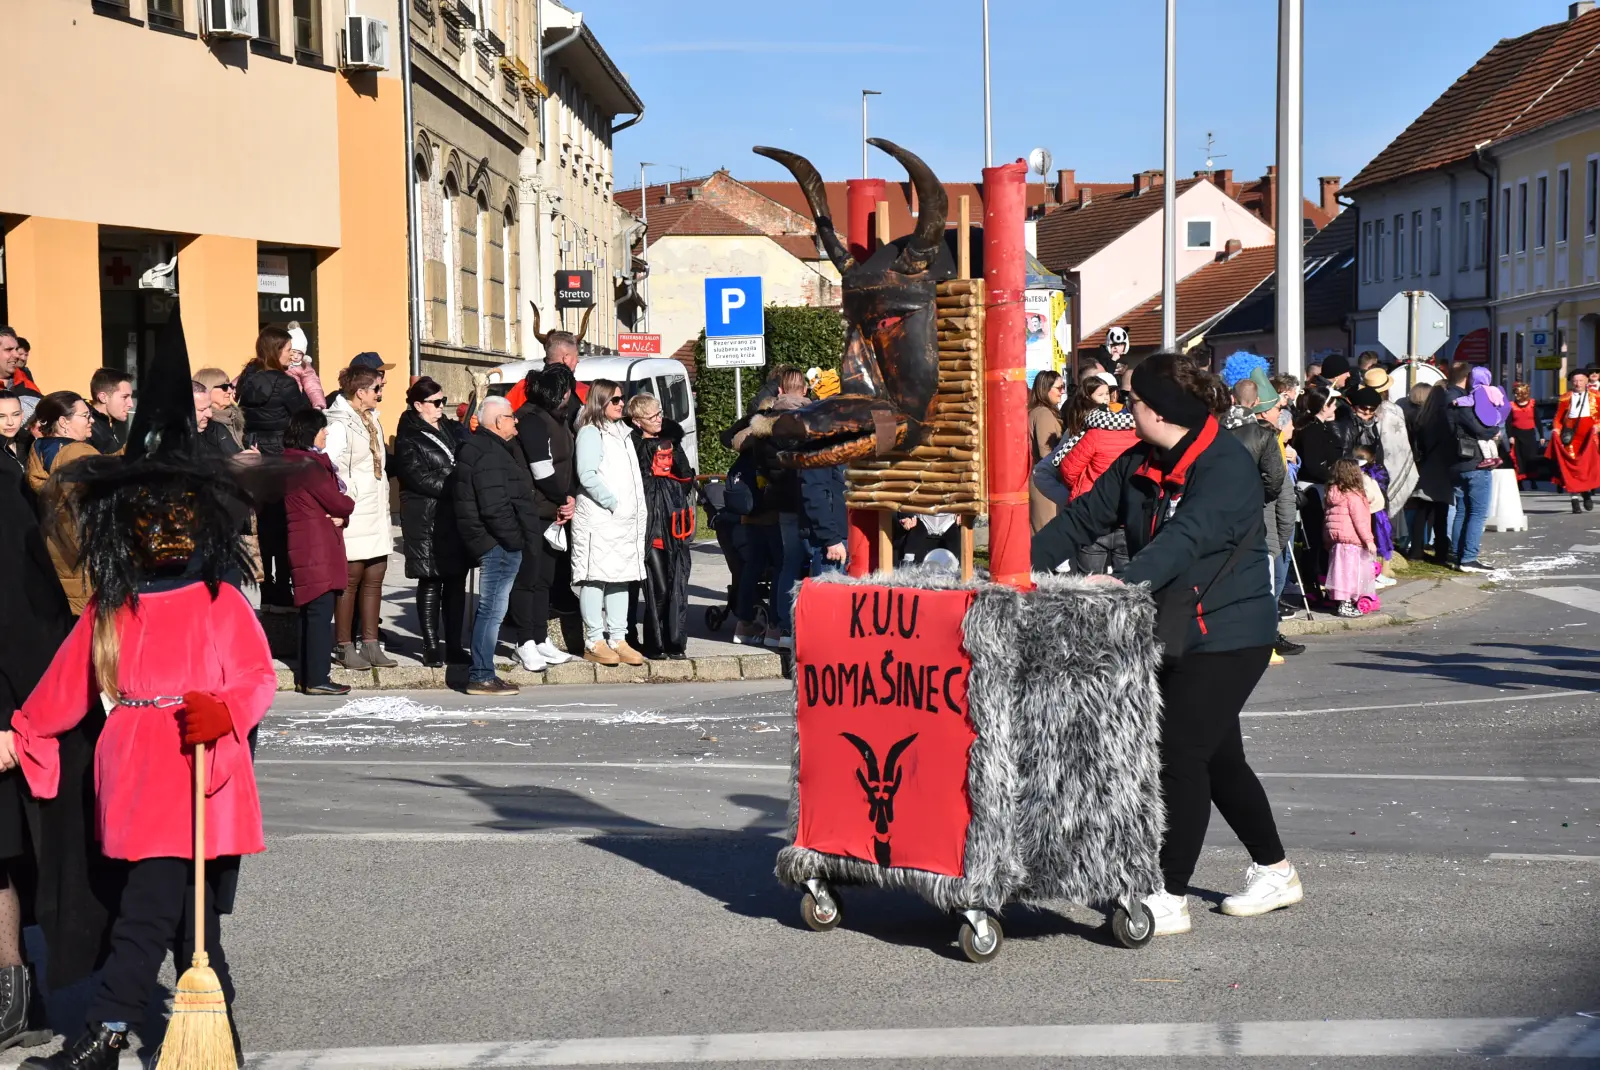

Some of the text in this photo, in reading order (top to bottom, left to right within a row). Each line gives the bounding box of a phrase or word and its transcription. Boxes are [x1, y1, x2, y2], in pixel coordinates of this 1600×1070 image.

[559, 290, 591, 299] Stretto
[722, 288, 746, 324] P
[631, 341, 655, 352] Neli
[849, 589, 920, 639] K.U.U.
[803, 649, 962, 715] DOMAŠINEC
